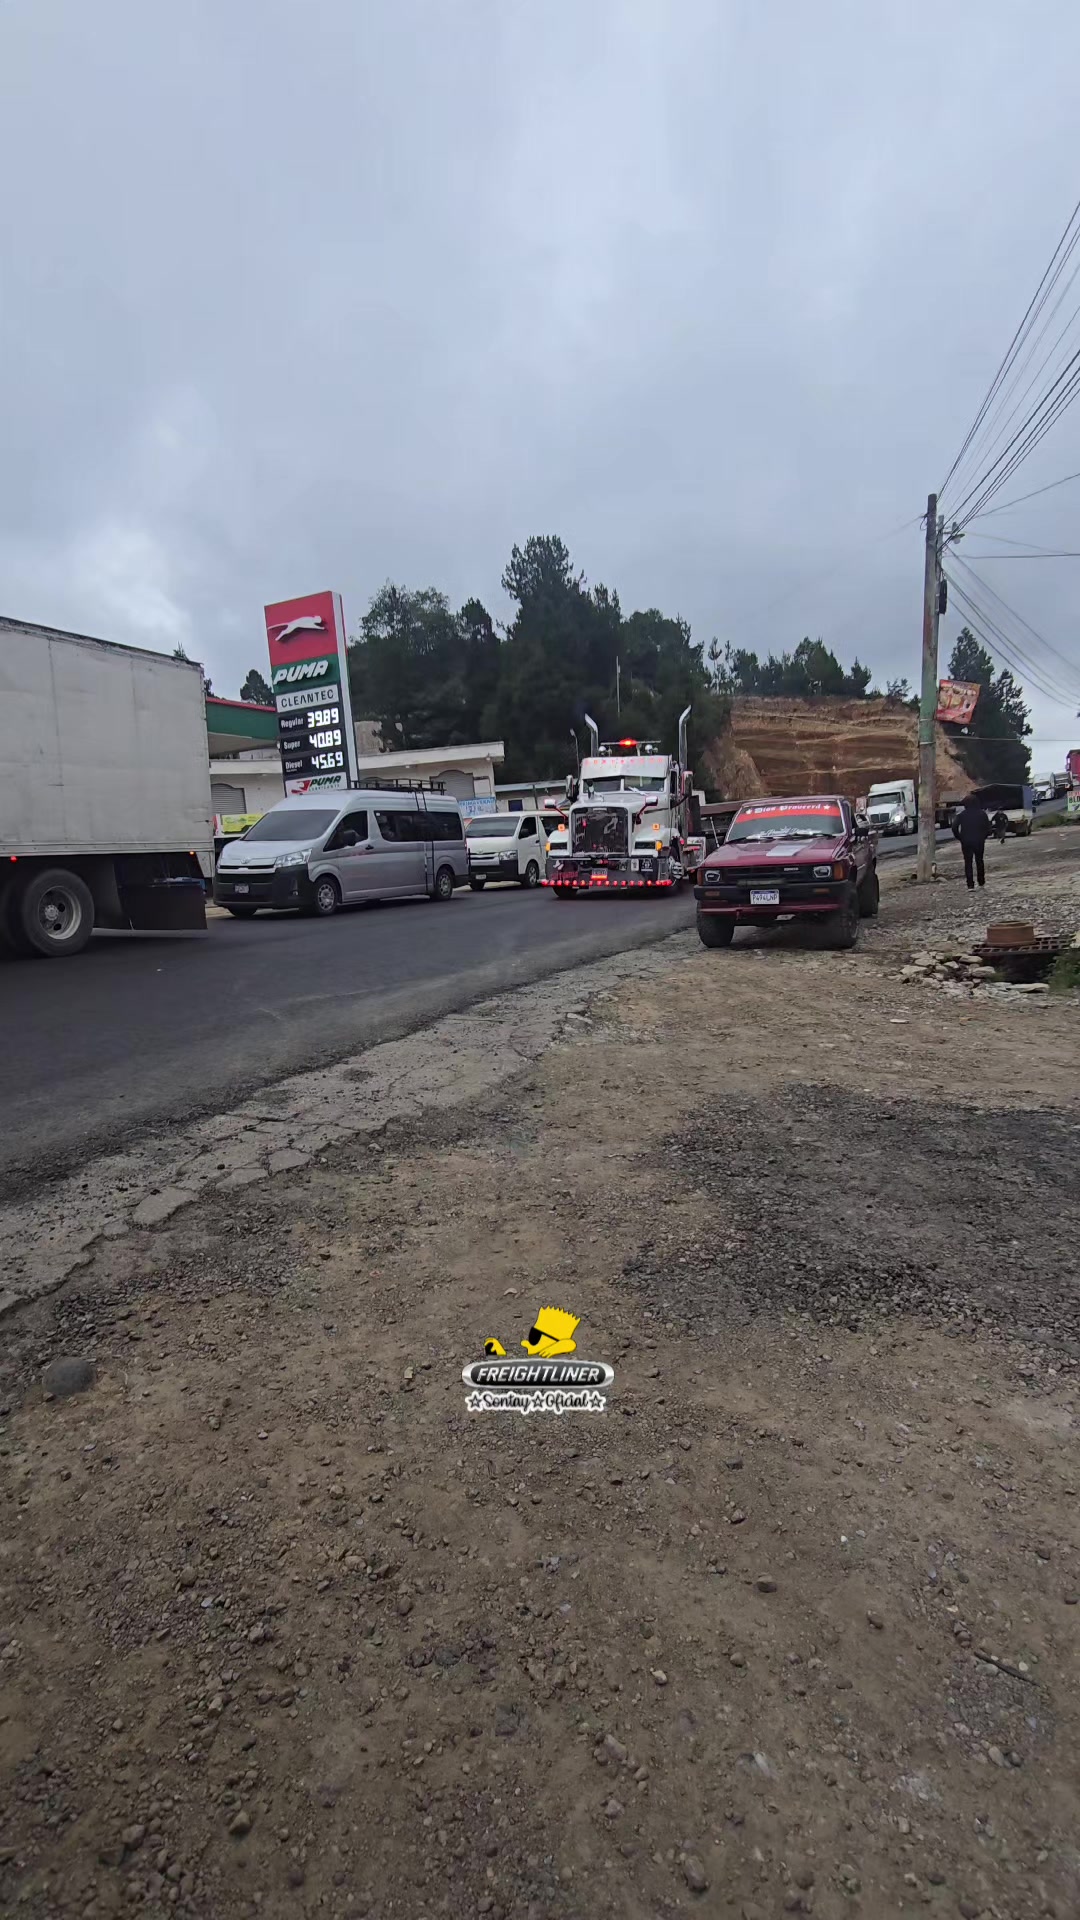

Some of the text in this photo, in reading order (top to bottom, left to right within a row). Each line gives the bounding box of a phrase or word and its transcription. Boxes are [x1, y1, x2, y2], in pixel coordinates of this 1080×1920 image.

[273, 660, 328, 685] PUMA
[281, 689, 334, 708] CLEANTEC
[280, 717, 304, 729] Regular
[283, 741, 301, 750] Super
[285, 760, 303, 769] Diesel
[310, 775, 342, 786] PUMA
[754, 806, 776, 814] Dios
